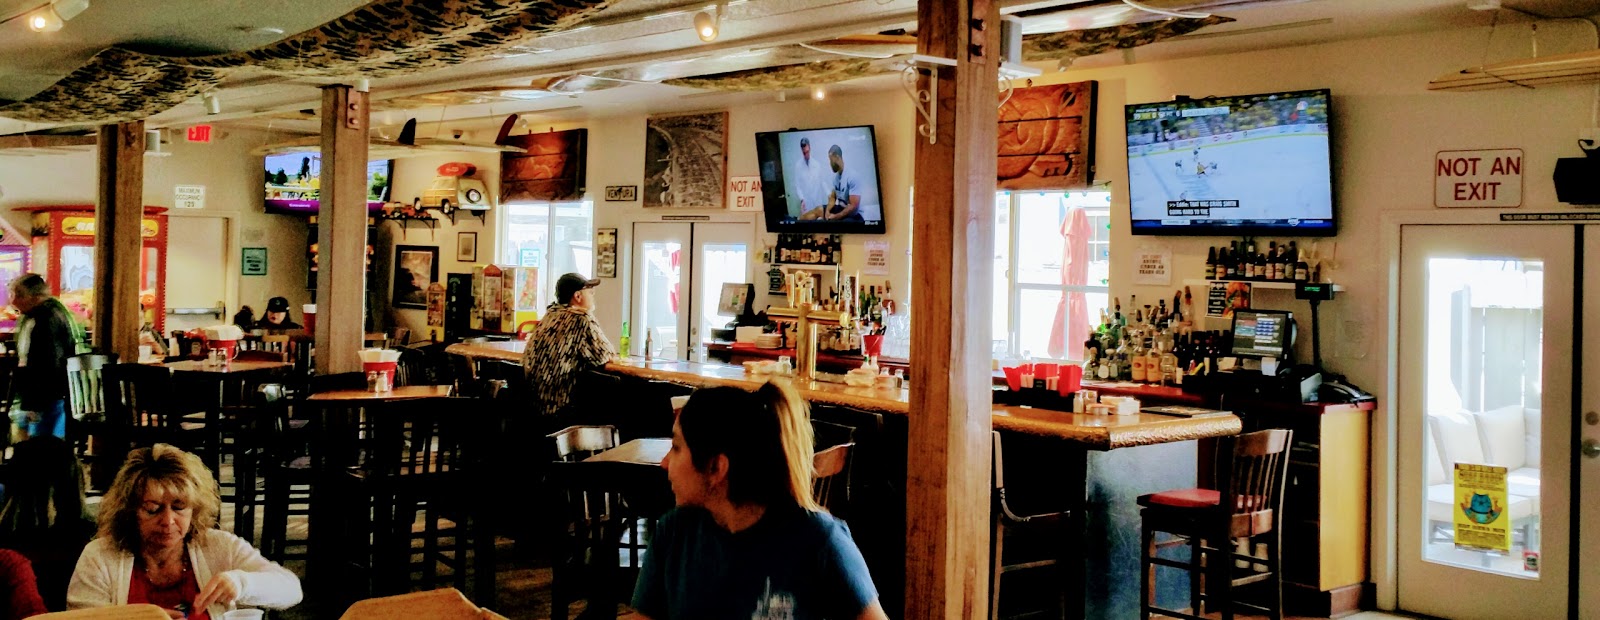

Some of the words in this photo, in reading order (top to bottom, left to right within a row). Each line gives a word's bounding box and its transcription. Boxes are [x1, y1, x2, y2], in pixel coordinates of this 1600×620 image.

[188, 126, 211, 142] EXIT
[1437, 157, 1482, 176] NOT
[1490, 156, 1521, 175] AN
[730, 180, 748, 193] NOT
[1454, 182, 1501, 200] EXIT
[736, 195, 756, 208] EXIT
